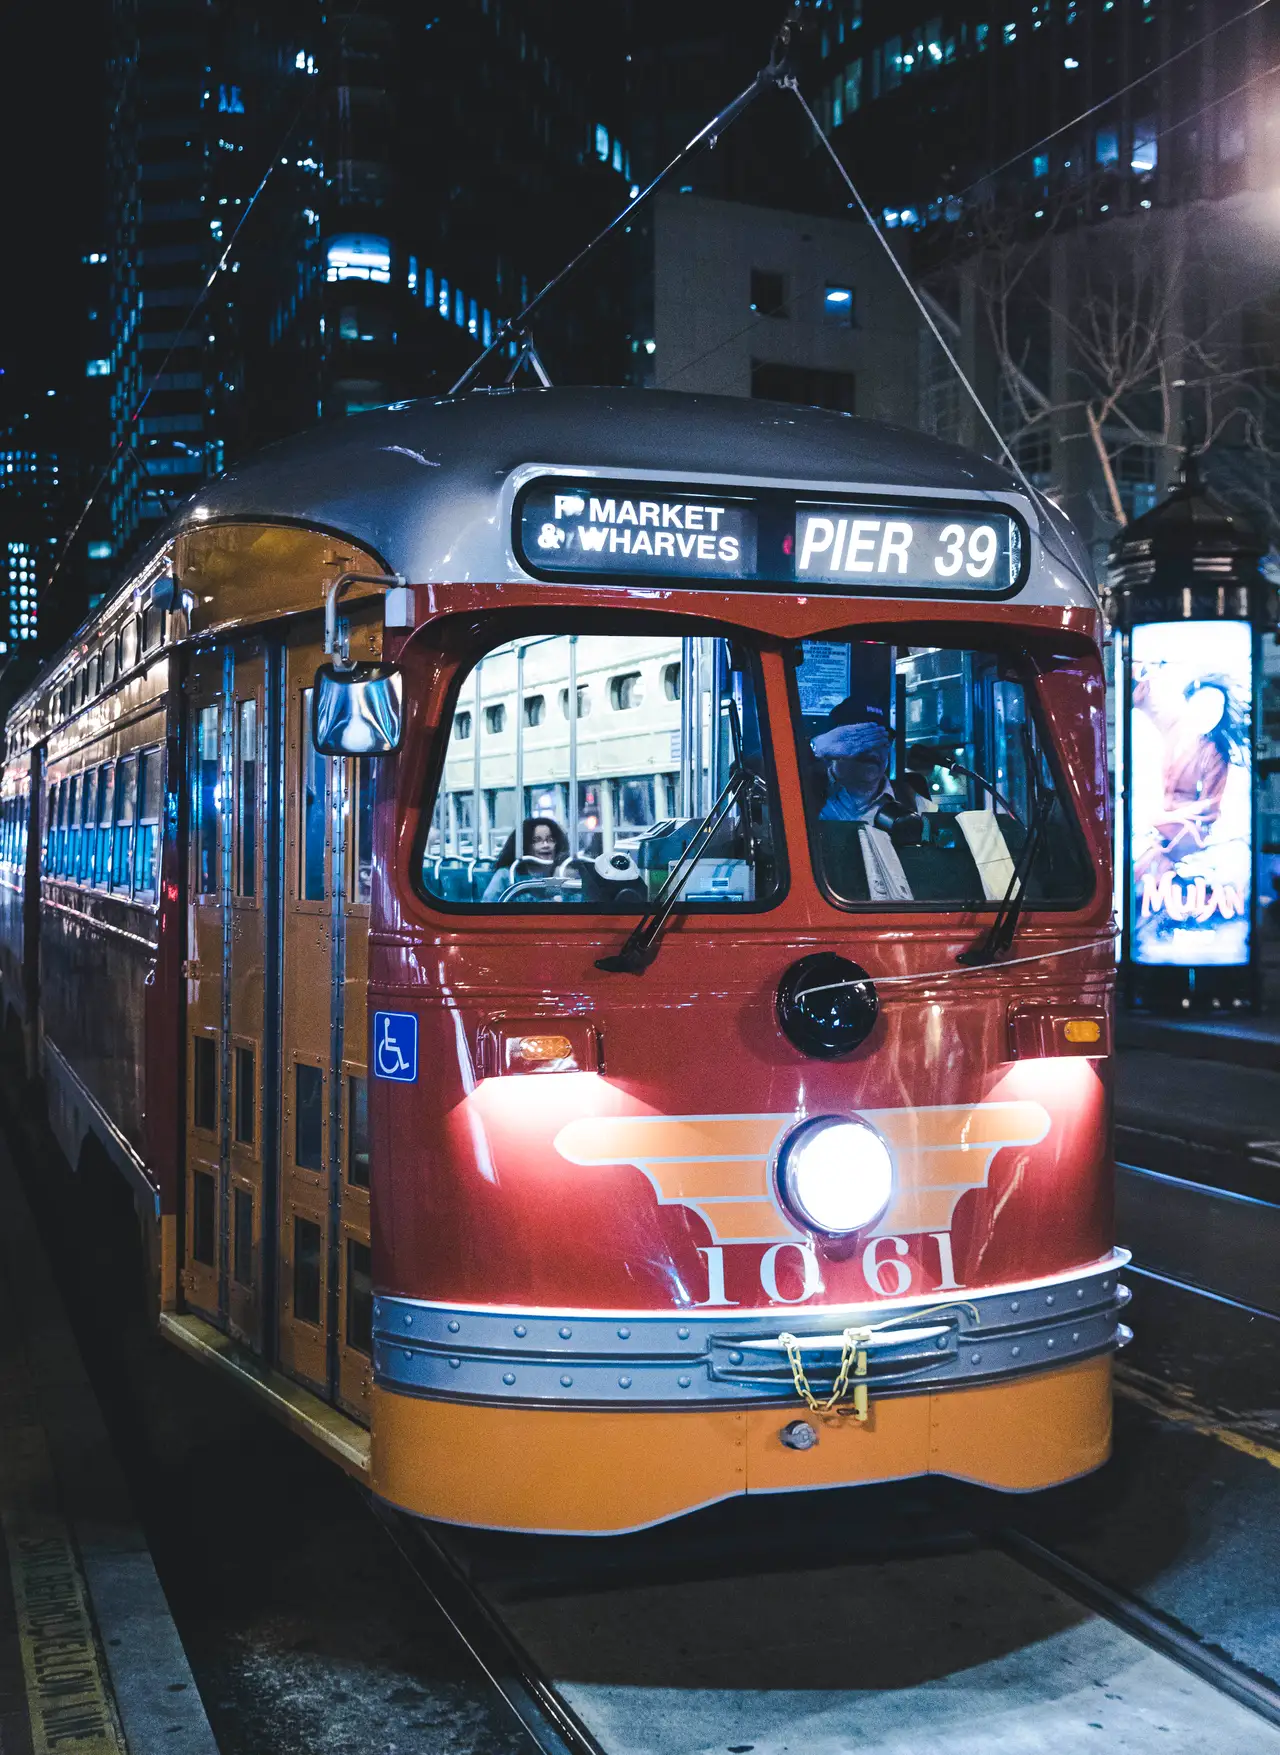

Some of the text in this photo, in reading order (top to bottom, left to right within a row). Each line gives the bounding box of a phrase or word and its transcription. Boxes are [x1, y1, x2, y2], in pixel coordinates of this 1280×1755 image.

[589, 498, 725, 532] MARKET
[537, 522, 740, 562] & WHARVES
[798, 518, 998, 578] PIER 39
[1141, 871, 1245, 923] MULAN
[694, 1233, 966, 1307] 1061
[27, 1628, 97, 1698] YELLOW
[41, 1700, 106, 1750] LINE
